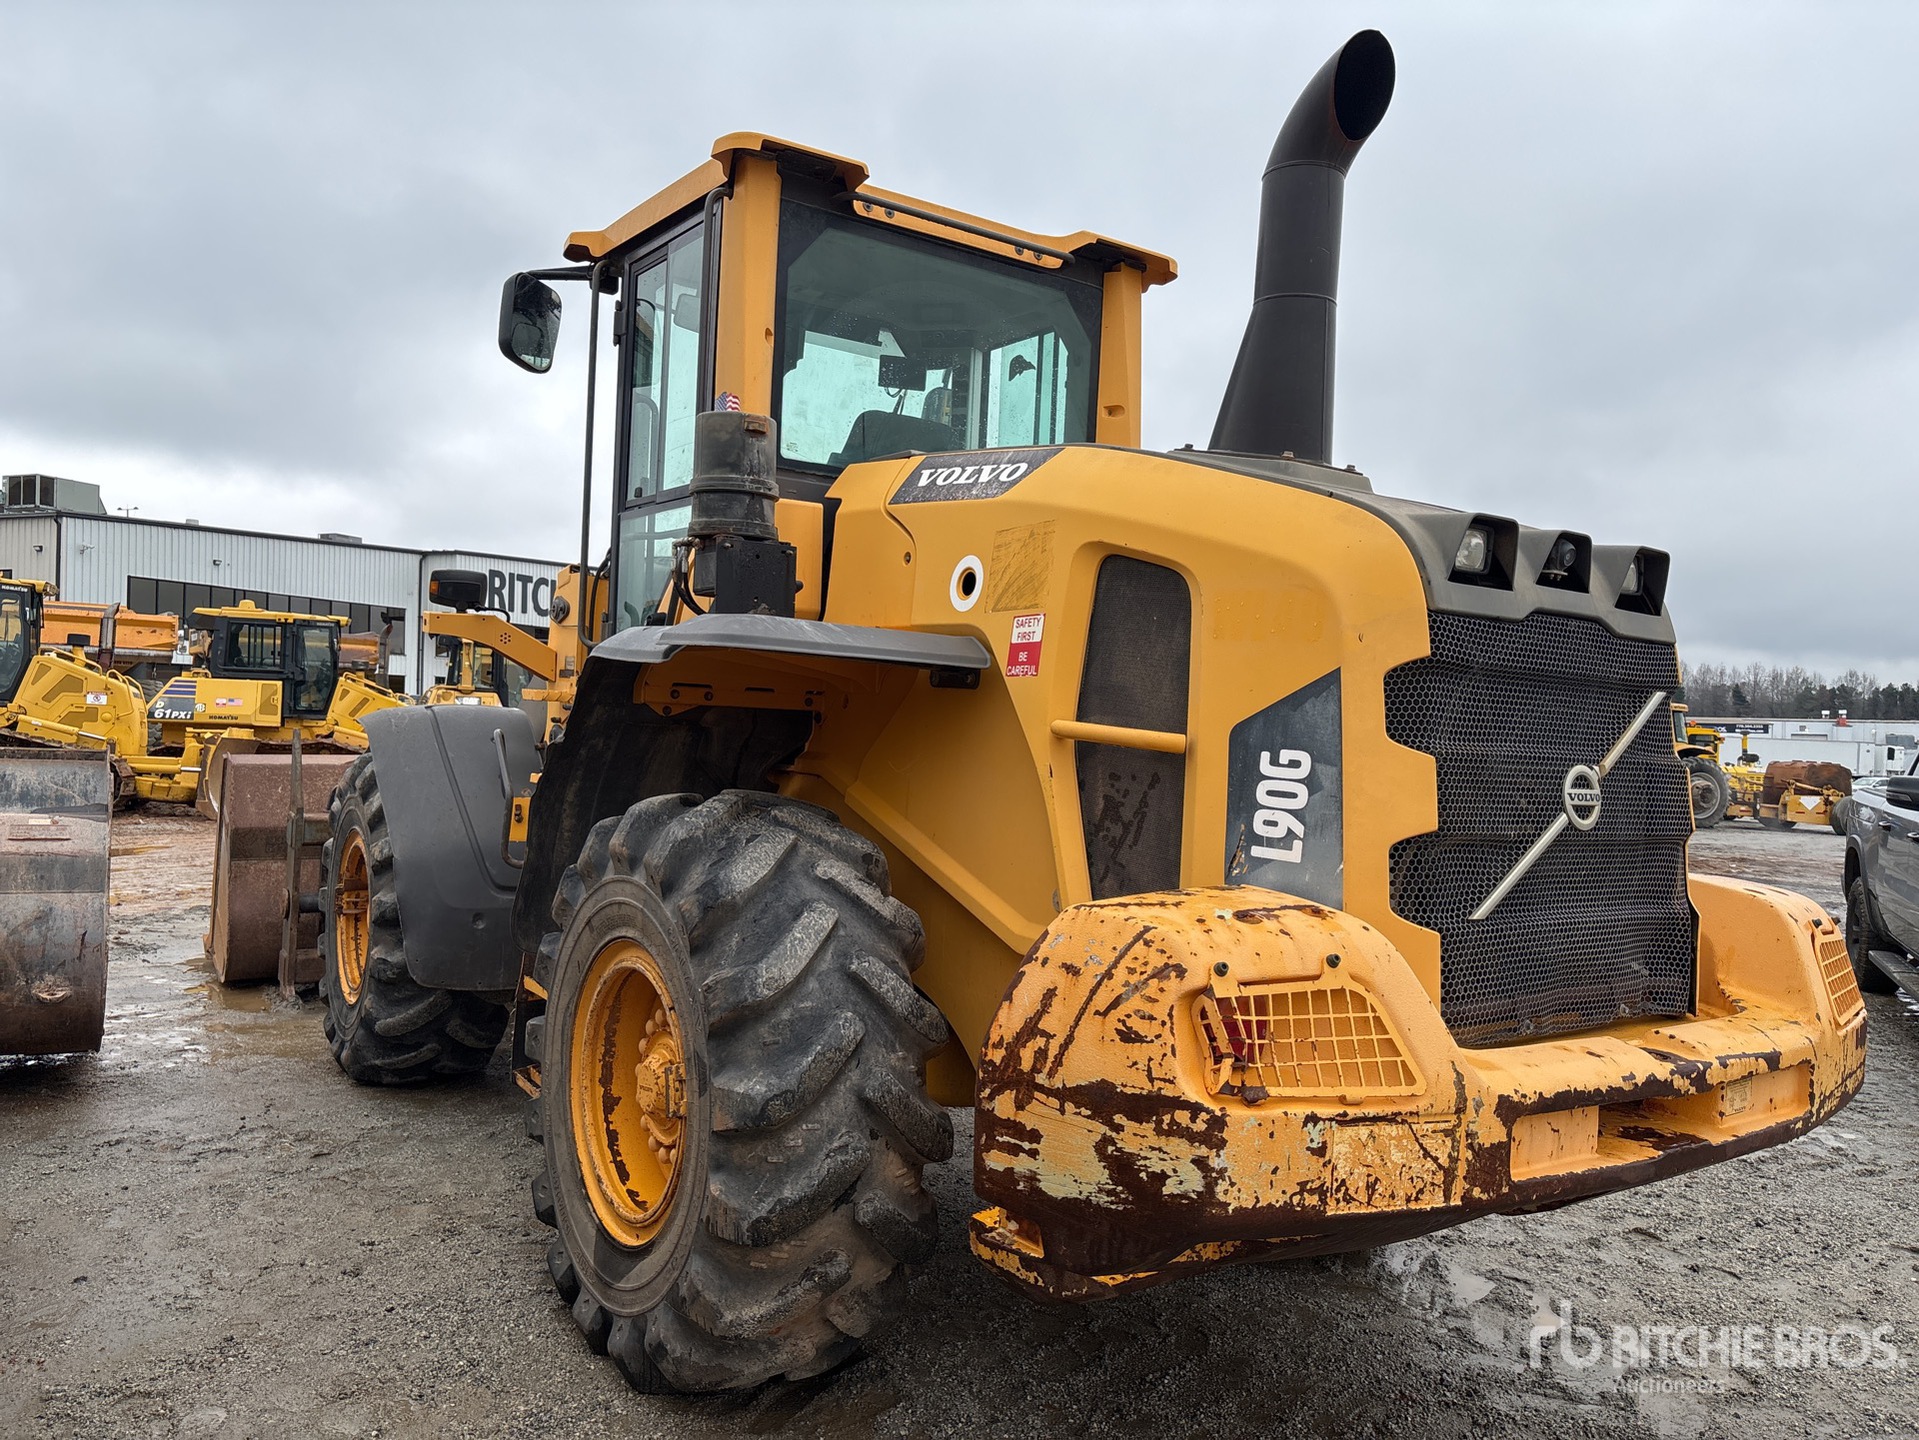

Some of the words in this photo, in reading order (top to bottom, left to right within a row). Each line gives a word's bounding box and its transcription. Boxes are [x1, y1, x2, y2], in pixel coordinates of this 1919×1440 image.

[917, 462, 1028, 487] VOLVO
[1015, 617, 1042, 629] SAFETY
[1016, 631, 1036, 642] FIRST
[1018, 651, 1028, 662] BE
[1006, 665, 1037, 676] CAREFUL
[155, 700, 165, 708] D
[154, 709, 192, 719] 61PXi
[1567, 792, 1601, 802] VOLVO
[1250, 749, 1312, 864] L90G
